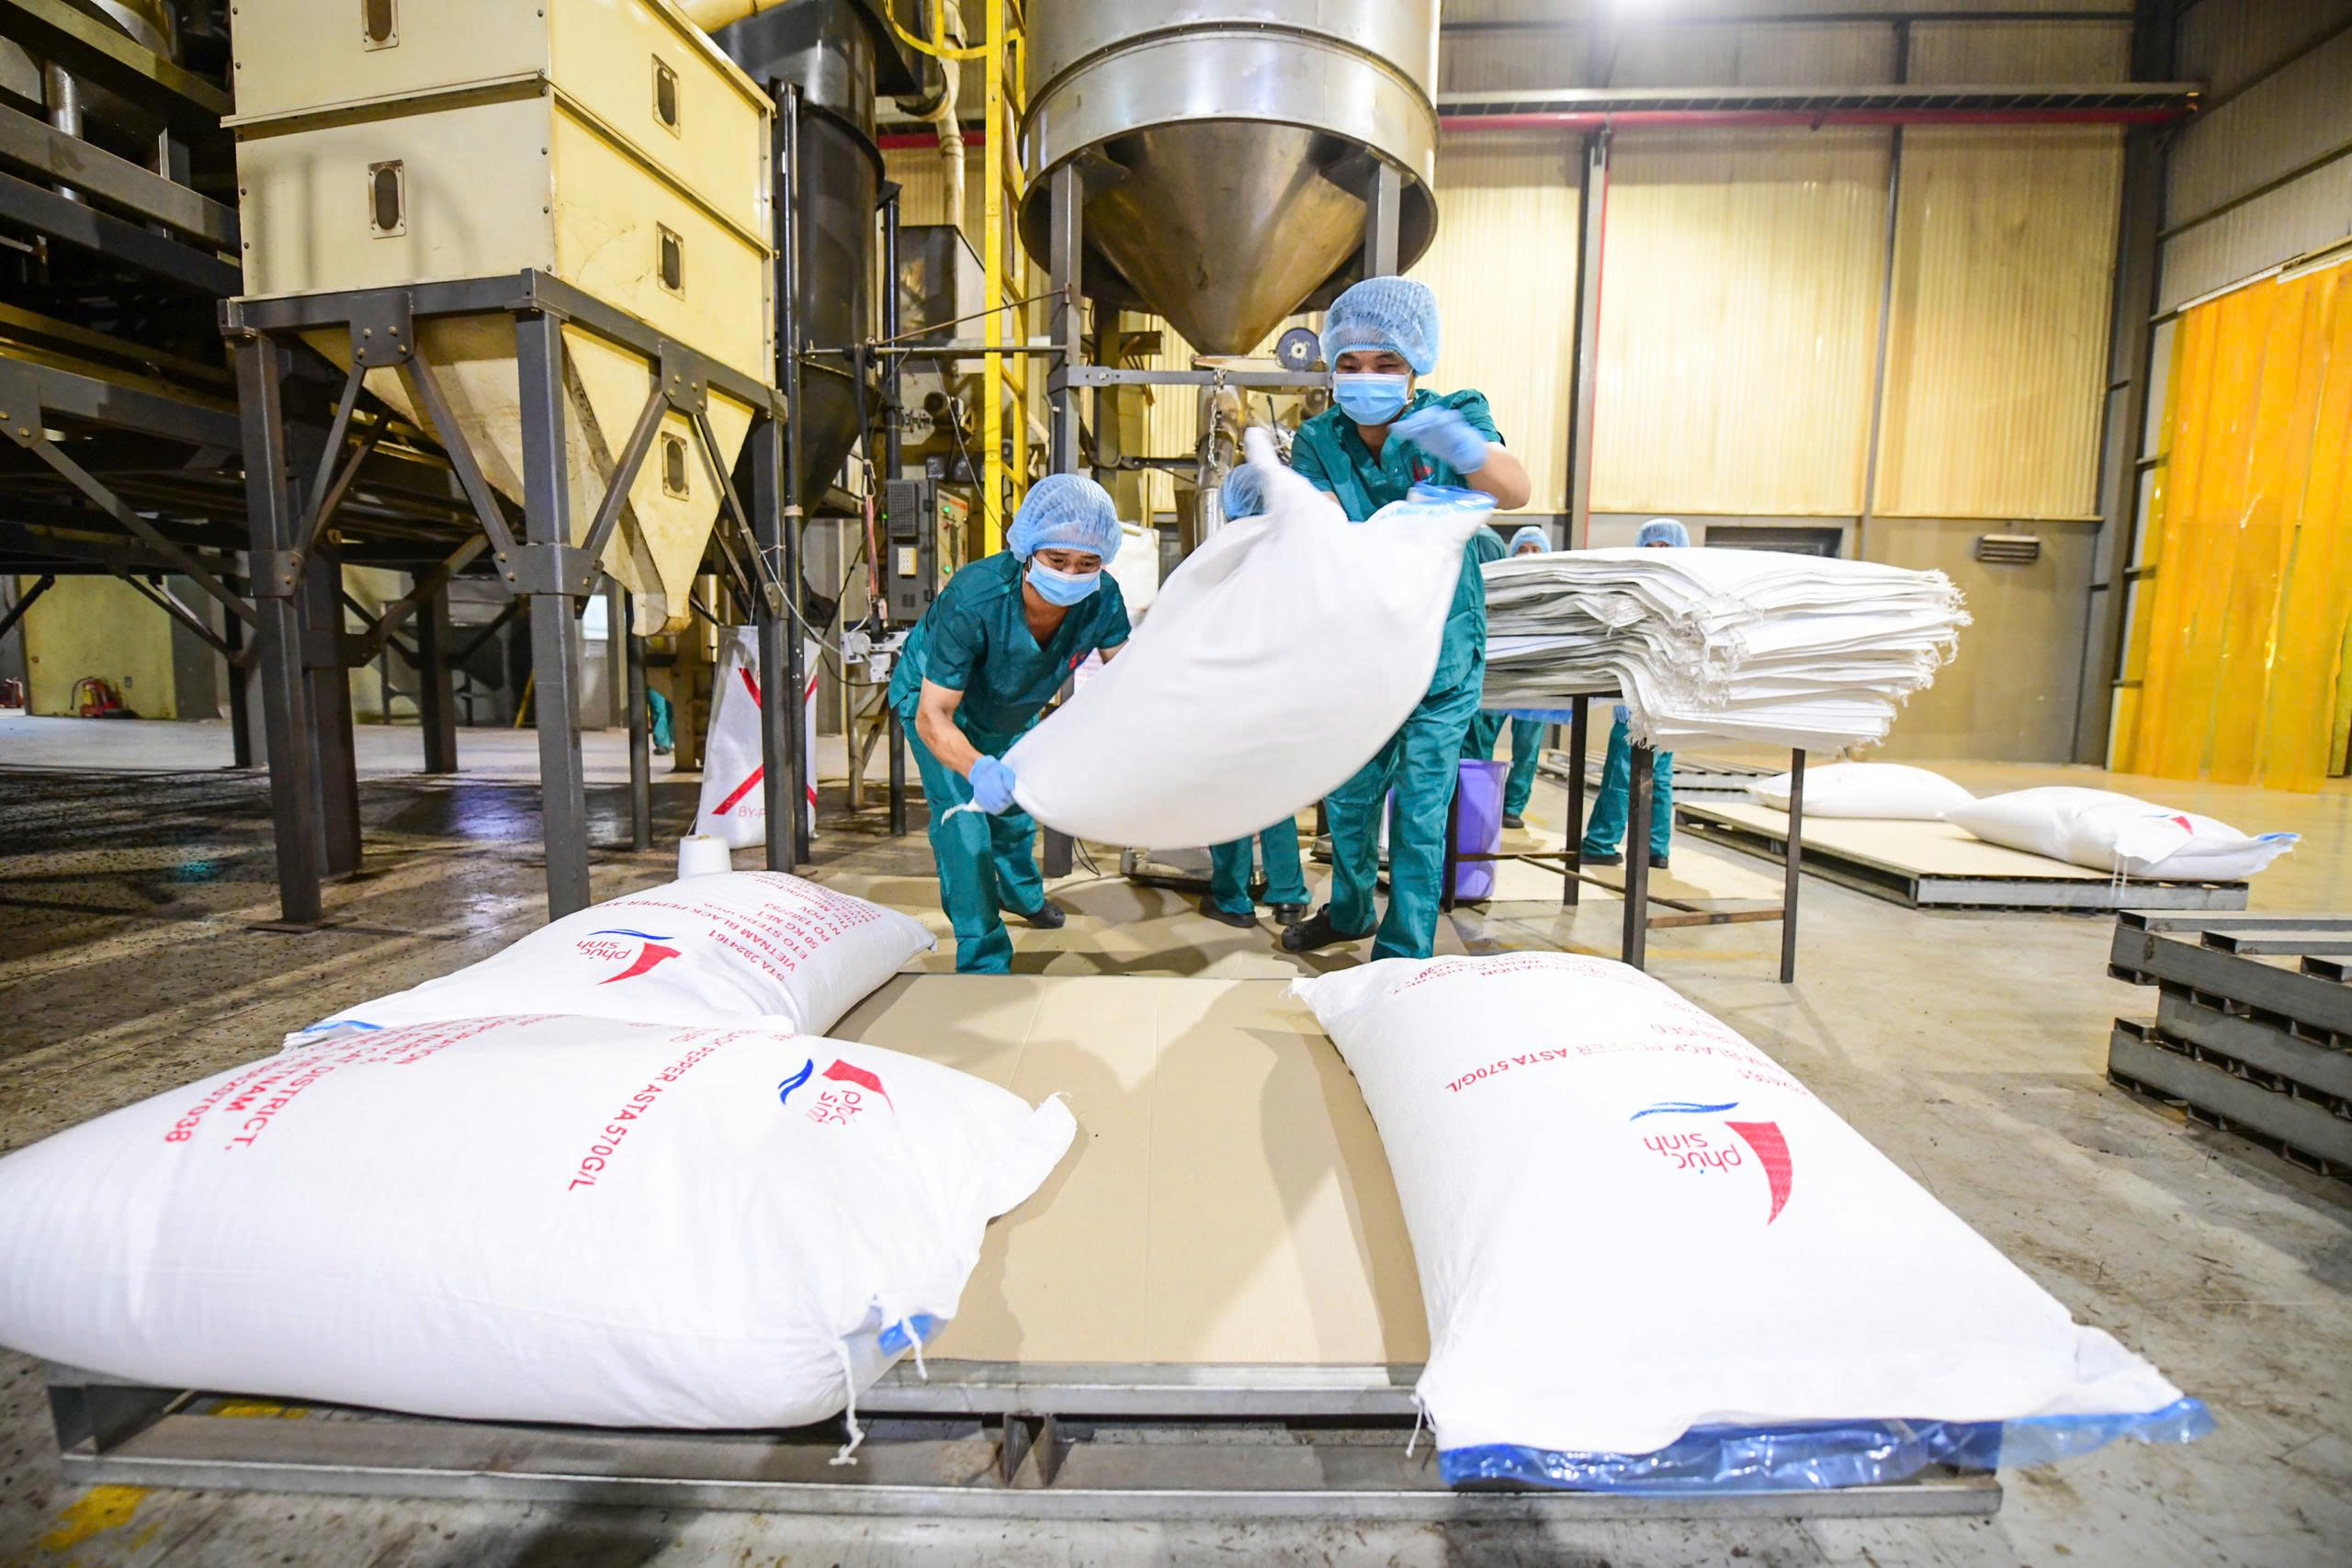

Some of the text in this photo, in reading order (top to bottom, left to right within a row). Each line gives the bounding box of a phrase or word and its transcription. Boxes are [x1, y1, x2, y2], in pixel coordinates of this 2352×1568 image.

[691, 908, 741, 931] BLACK
[785, 921, 805, 937] KG
[799, 906, 841, 936] NY POV
[576, 940, 620, 950] sinh
[813, 926, 831, 942] PO
[579, 949, 632, 961] phúc
[741, 929, 796, 971] VIETNAM
[783, 938, 808, 960] ETO
[762, 960, 786, 982] STA
[654, 1045, 716, 1082] PEPPER
[1511, 1048, 1567, 1066] ASTA
[1445, 1060, 1510, 1092] 570G/L
[614, 1084, 663, 1121] ASTA
[1644, 1133, 1708, 1156] sinh
[568, 1124, 628, 1191] 570G/L
[1671, 1144, 1742, 1174] phúc
